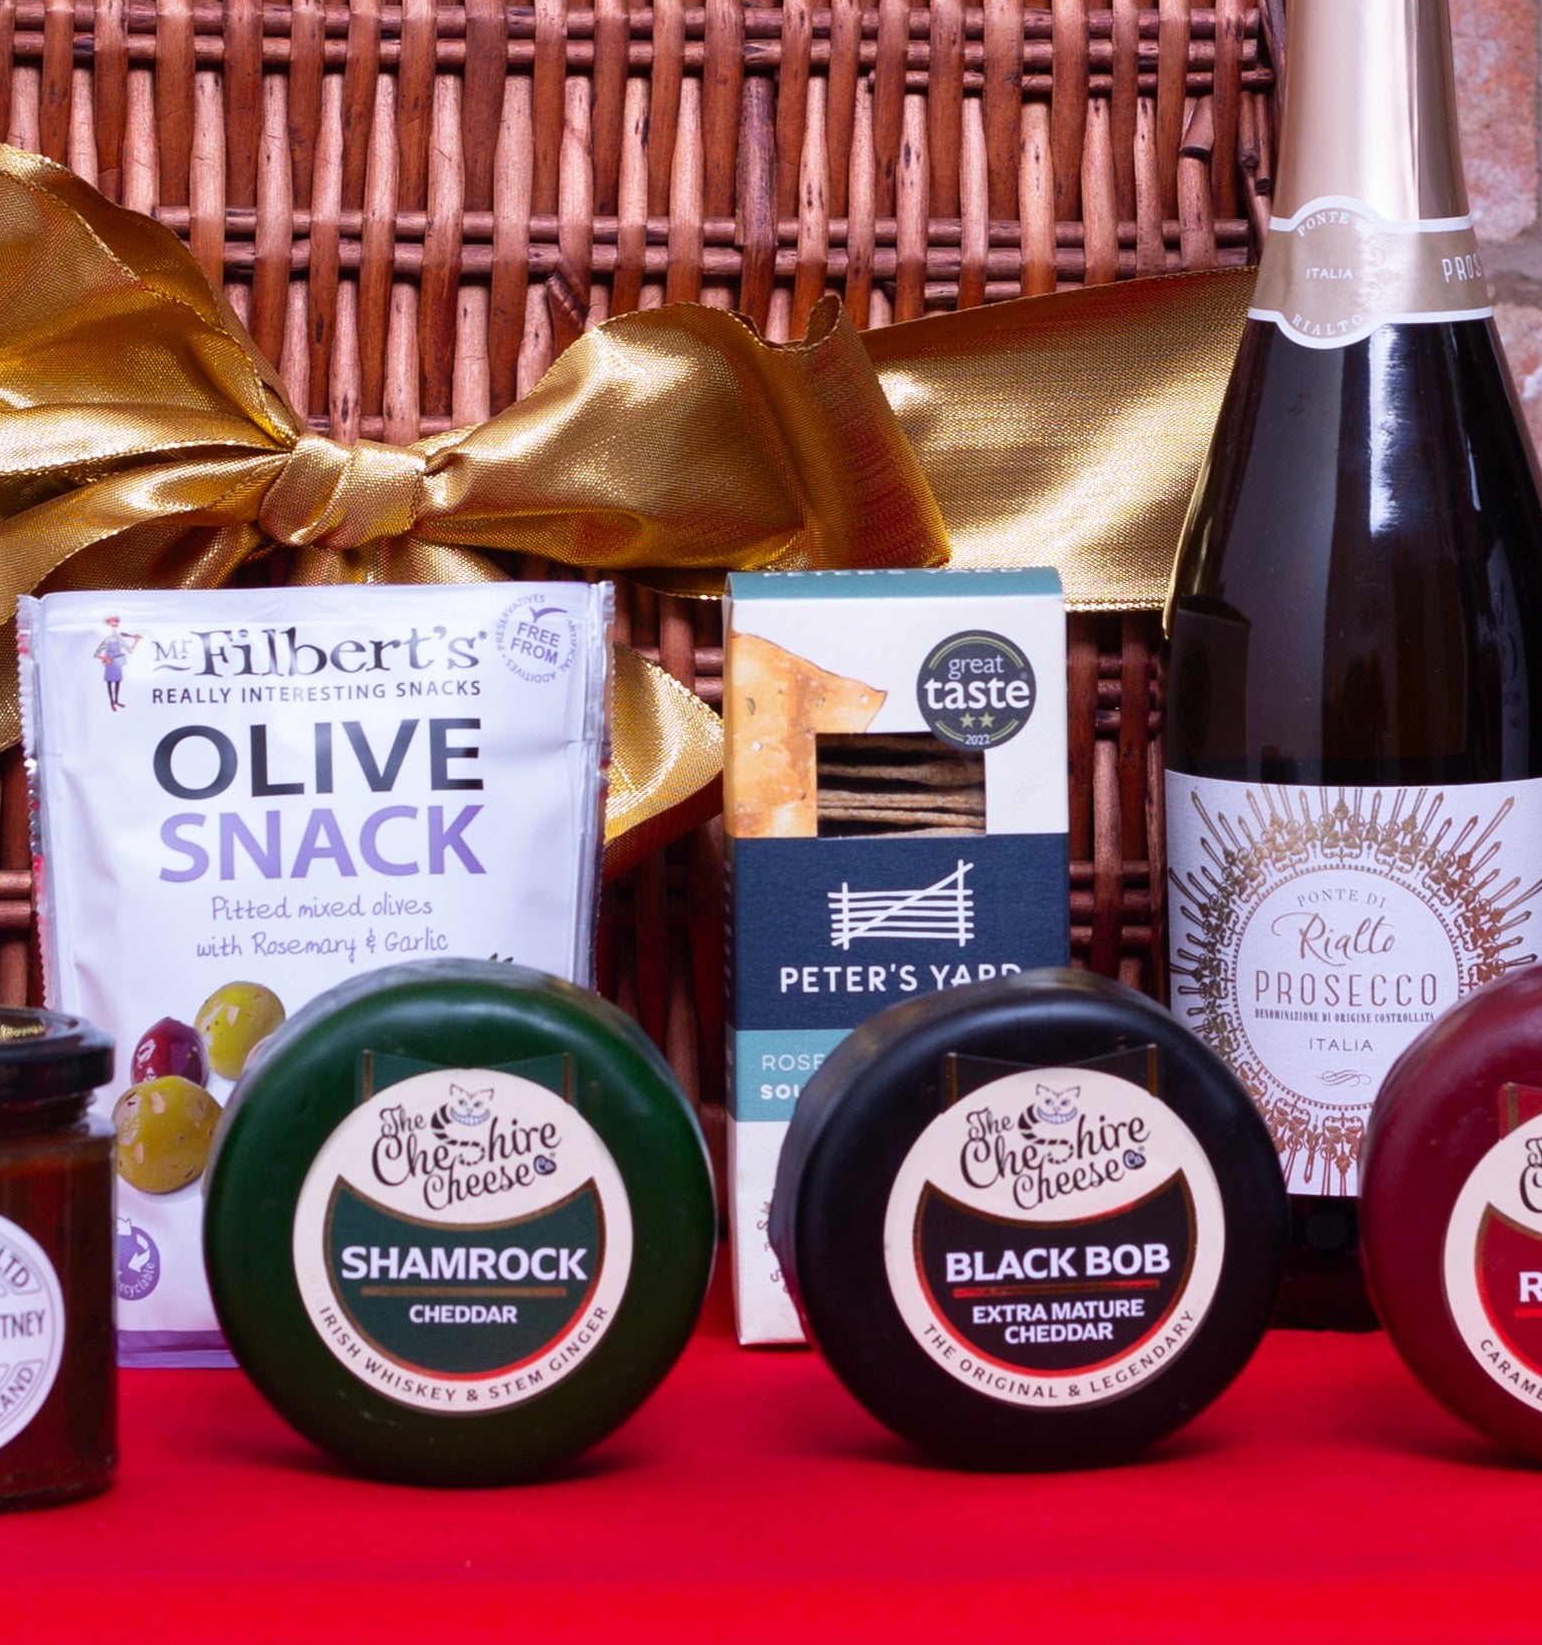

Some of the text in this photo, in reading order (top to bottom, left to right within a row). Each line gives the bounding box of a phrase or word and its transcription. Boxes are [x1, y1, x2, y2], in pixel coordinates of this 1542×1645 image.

[1297, 211, 1350, 238] PONTE
[1306, 267, 1354, 280] ITALIA
[1291, 313, 1364, 337] RIALTO
[517, 621, 562, 648] FREE
[190, 625, 480, 678] Filbert's
[510, 637, 559, 665] FROM
[948, 655, 1005, 680] great
[152, 680, 482, 704] REALLY INTERESTING SNACKS
[923, 677, 1031, 710] taste
[965, 732, 992, 745] 2022
[152, 717, 485, 801] OLIVE
[158, 804, 488, 883] SNACK
[211, 892, 433, 922] Pitted mixed olives
[1296, 887, 1387, 909] PONTE DI
[196, 934, 244, 959] with
[251, 932, 358, 964] Rosemary
[385, 931, 449, 954] Garlic
[1271, 911, 1396, 967] Rialto
[779, 962, 918, 994] PETER'S
[1255, 970, 1438, 1008] PROSECCO
[1255, 1008, 1435, 1024] DENOMINAZIONE DI ORIGINE CONTROLLATA
[1309, 1038, 1374, 1052] ITALIA
[378, 1104, 429, 1138] The
[965, 1105, 1015, 1139] The
[422, 1159, 536, 1211] Cheese
[1012, 1159, 1125, 1211] Cheese
[341, 1245, 588, 1282] SHAMROCK
[945, 1243, 1171, 1283] BLACK BOB
[409, 1304, 518, 1324] CHEDDAR
[972, 1297, 1146, 1325] EXTRA MATURE
[1004, 1322, 1114, 1345] CHEDDAR
[319, 1304, 610, 1402] IRISH WHISKEY & STEM GINGER
[923, 1309, 1197, 1400] THE ORIGINAL & LEGENDARY
